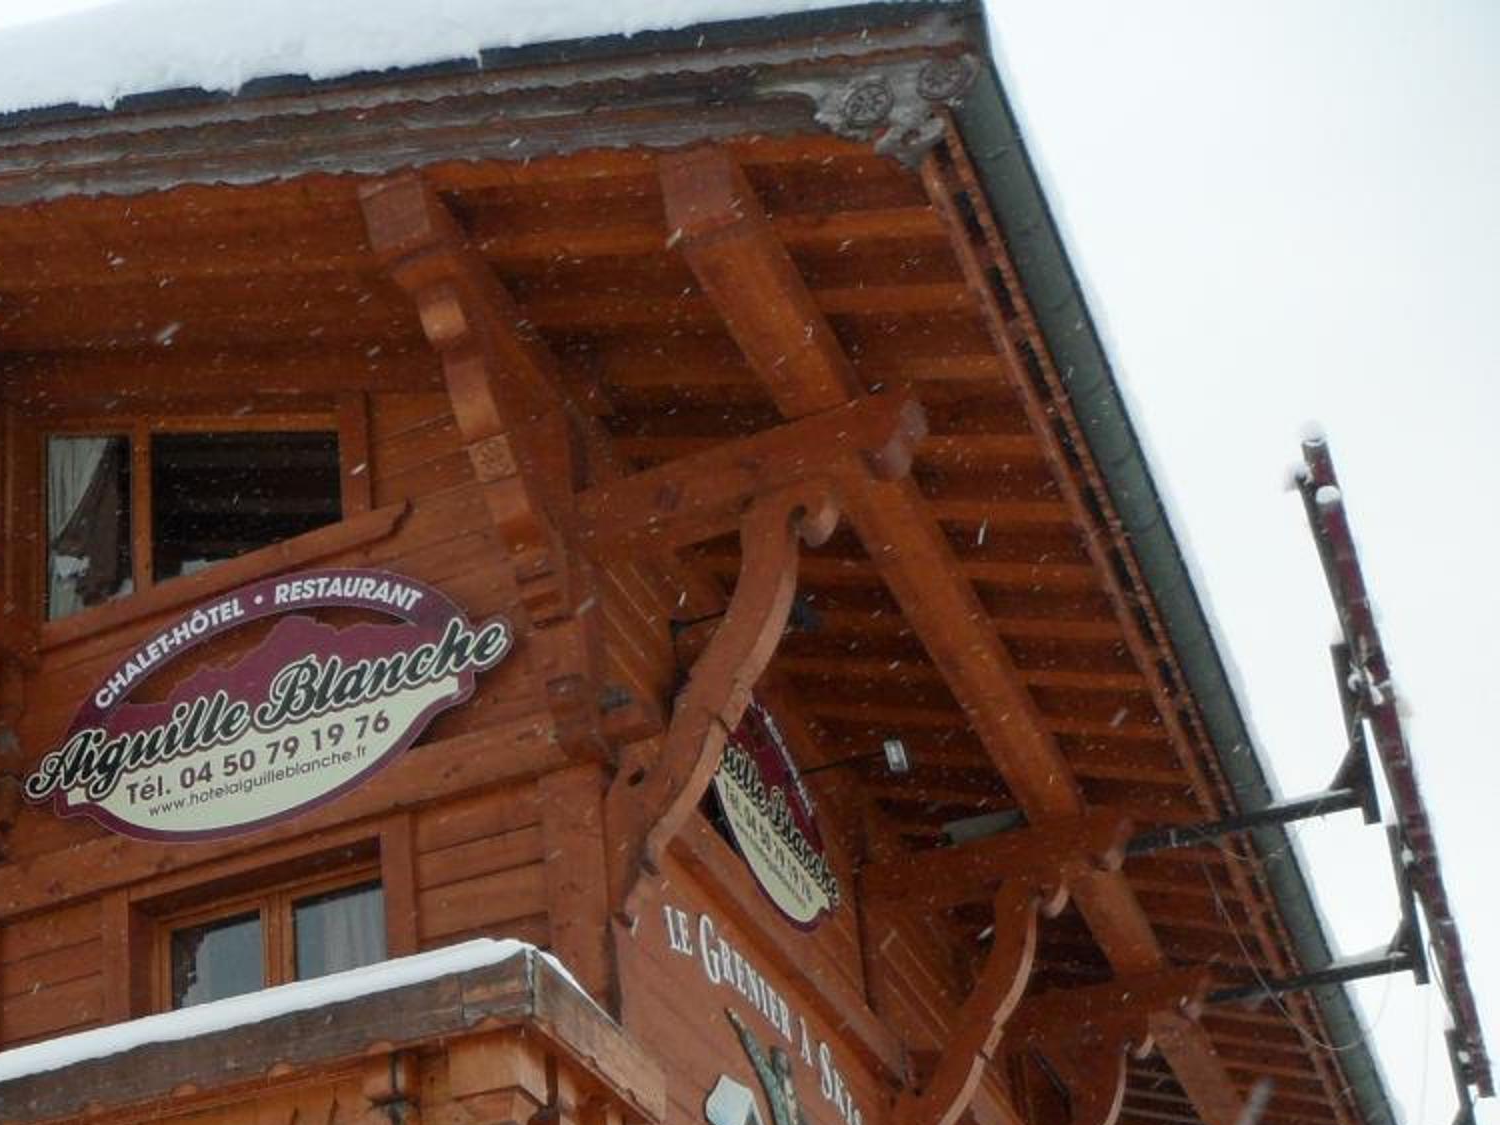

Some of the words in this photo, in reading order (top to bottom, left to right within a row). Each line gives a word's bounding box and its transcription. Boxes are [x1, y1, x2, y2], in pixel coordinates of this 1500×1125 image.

[27, 690, 249, 797] Aiguille
[255, 618, 506, 728] Blanche
[95, 598, 244, 708] CHALET-HÔTEL
[275, 577, 422, 611] RESTAURANT
[126, 774, 171, 806] Tél.
[180, 761, 212, 789] 04
[223, 749, 255, 777] 50
[266, 735, 300, 765] 79
[311, 723, 344, 751] 19
[355, 710, 390, 739] 76
[149, 745, 367, 816] www.hotelaiguilleblanche.fr
[663, 905, 693, 956] LE
[700, 914, 792, 1042] GRENIER
